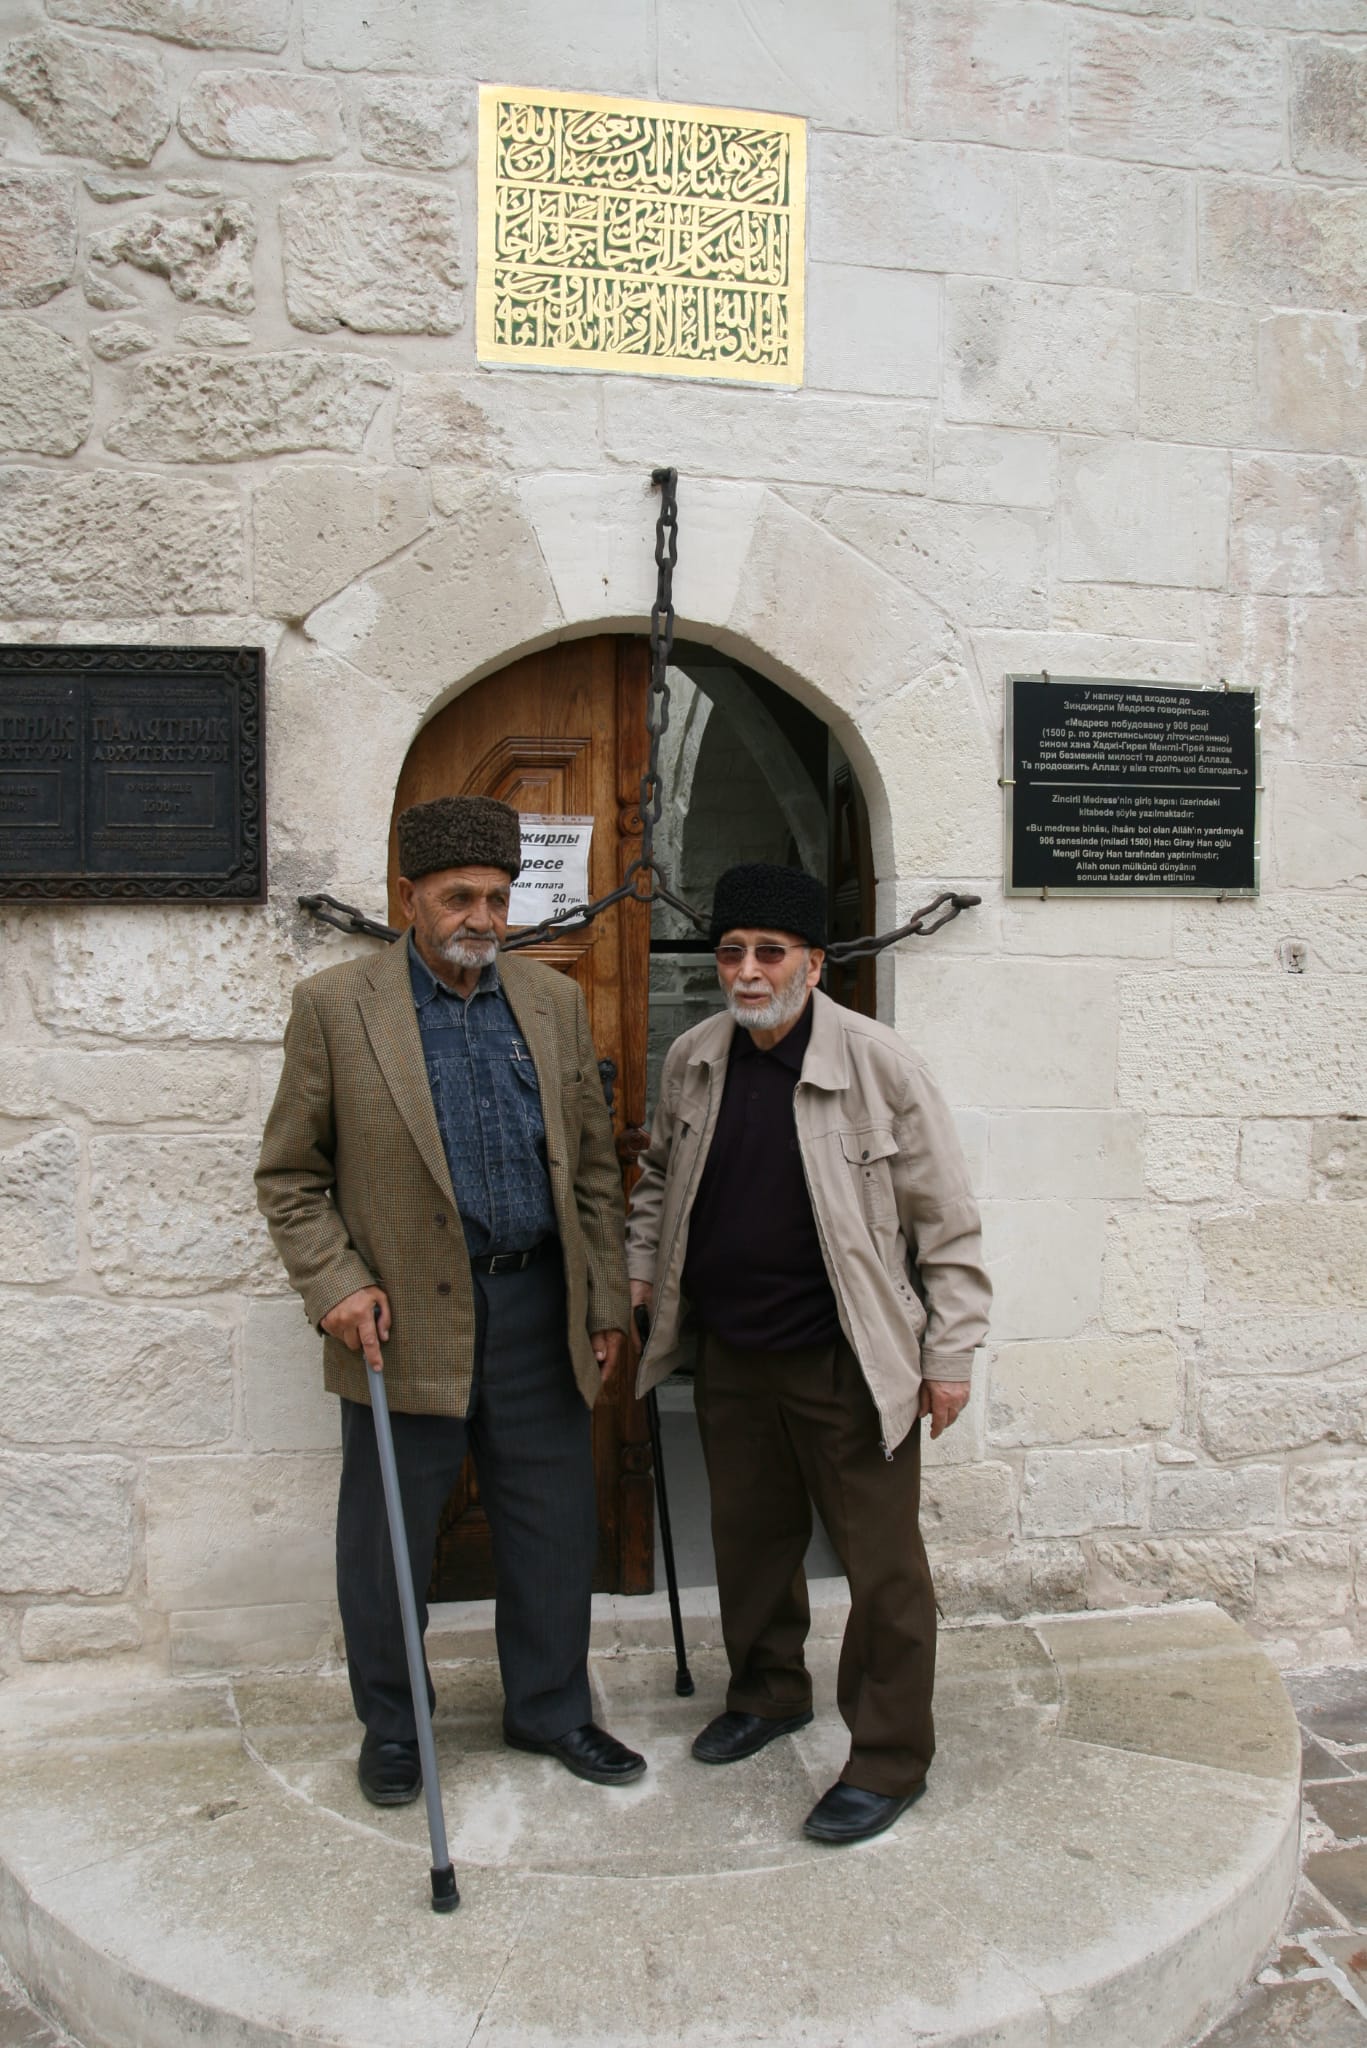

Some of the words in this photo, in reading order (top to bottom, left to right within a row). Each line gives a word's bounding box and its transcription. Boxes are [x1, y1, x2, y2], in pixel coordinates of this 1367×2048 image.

[1092, 693, 1124, 703] напису
[1126, 694, 1143, 703] над
[1144, 695, 1177, 704] входом
[1178, 697, 1191, 706] до
[1116, 703, 1155, 714] Медресе
[1157, 706, 1210, 716] говориться:
[92, 717, 229, 742] ПАМЯТНИК
[1111, 720, 1164, 730] побудовано
[1166, 722, 1171, 731] у
[1173, 721, 1189, 730] 906
[1190, 723, 1209, 732] році
[1042, 728, 1066, 738] (1500
[1078, 730, 1090, 738] по
[1039, 740, 1068, 748] сином
[1070, 741, 1091, 749] хана
[1206, 745, 1233, 753] ханом
[92, 744, 230, 763] АРХИТЕКТУРЫ
[1039, 751, 1056, 760] при
[1058, 750, 1105, 760] безмежній
[1107, 753, 1143, 762] милості
[1144, 754, 1154, 762] та
[1155, 754, 1196, 764] допомозі
[1198, 755, 1232, 764] Аллаха.
[1021, 760, 1032, 770] Та
[1034, 763, 1090, 771] продовжить
[1092, 762, 1120, 772] Аллах
[1122, 765, 1127, 773] у
[1183, 766, 1196, 774] цю
[1051, 794, 1081, 804] Zincirli
[1179, 797, 1220, 806] üzerindeki
[1078, 808, 1114, 817] kitabede
[1044, 824, 1080, 833] medrese
[1138, 826, 1151, 834] bol
[1152, 826, 1170, 834] olan
[1039, 836, 1054, 845] 906
[1056, 837, 1099, 845] senesinde
[1130, 838, 1152, 848] 1500)
[1173, 838, 1195, 848] Giray
[1196, 839, 1212, 847] Han
[1214, 840, 1232, 849] oğlu
[1052, 849, 1080, 859] Mengli
[1082, 849, 1104, 860] Giray
[1106, 850, 1122, 858] Han
[1076, 862, 1097, 870] Allah
[1122, 862, 1157, 871] mülkünü
[1109, 873, 1132, 881] kadar
[552, 894, 566, 903] 20
